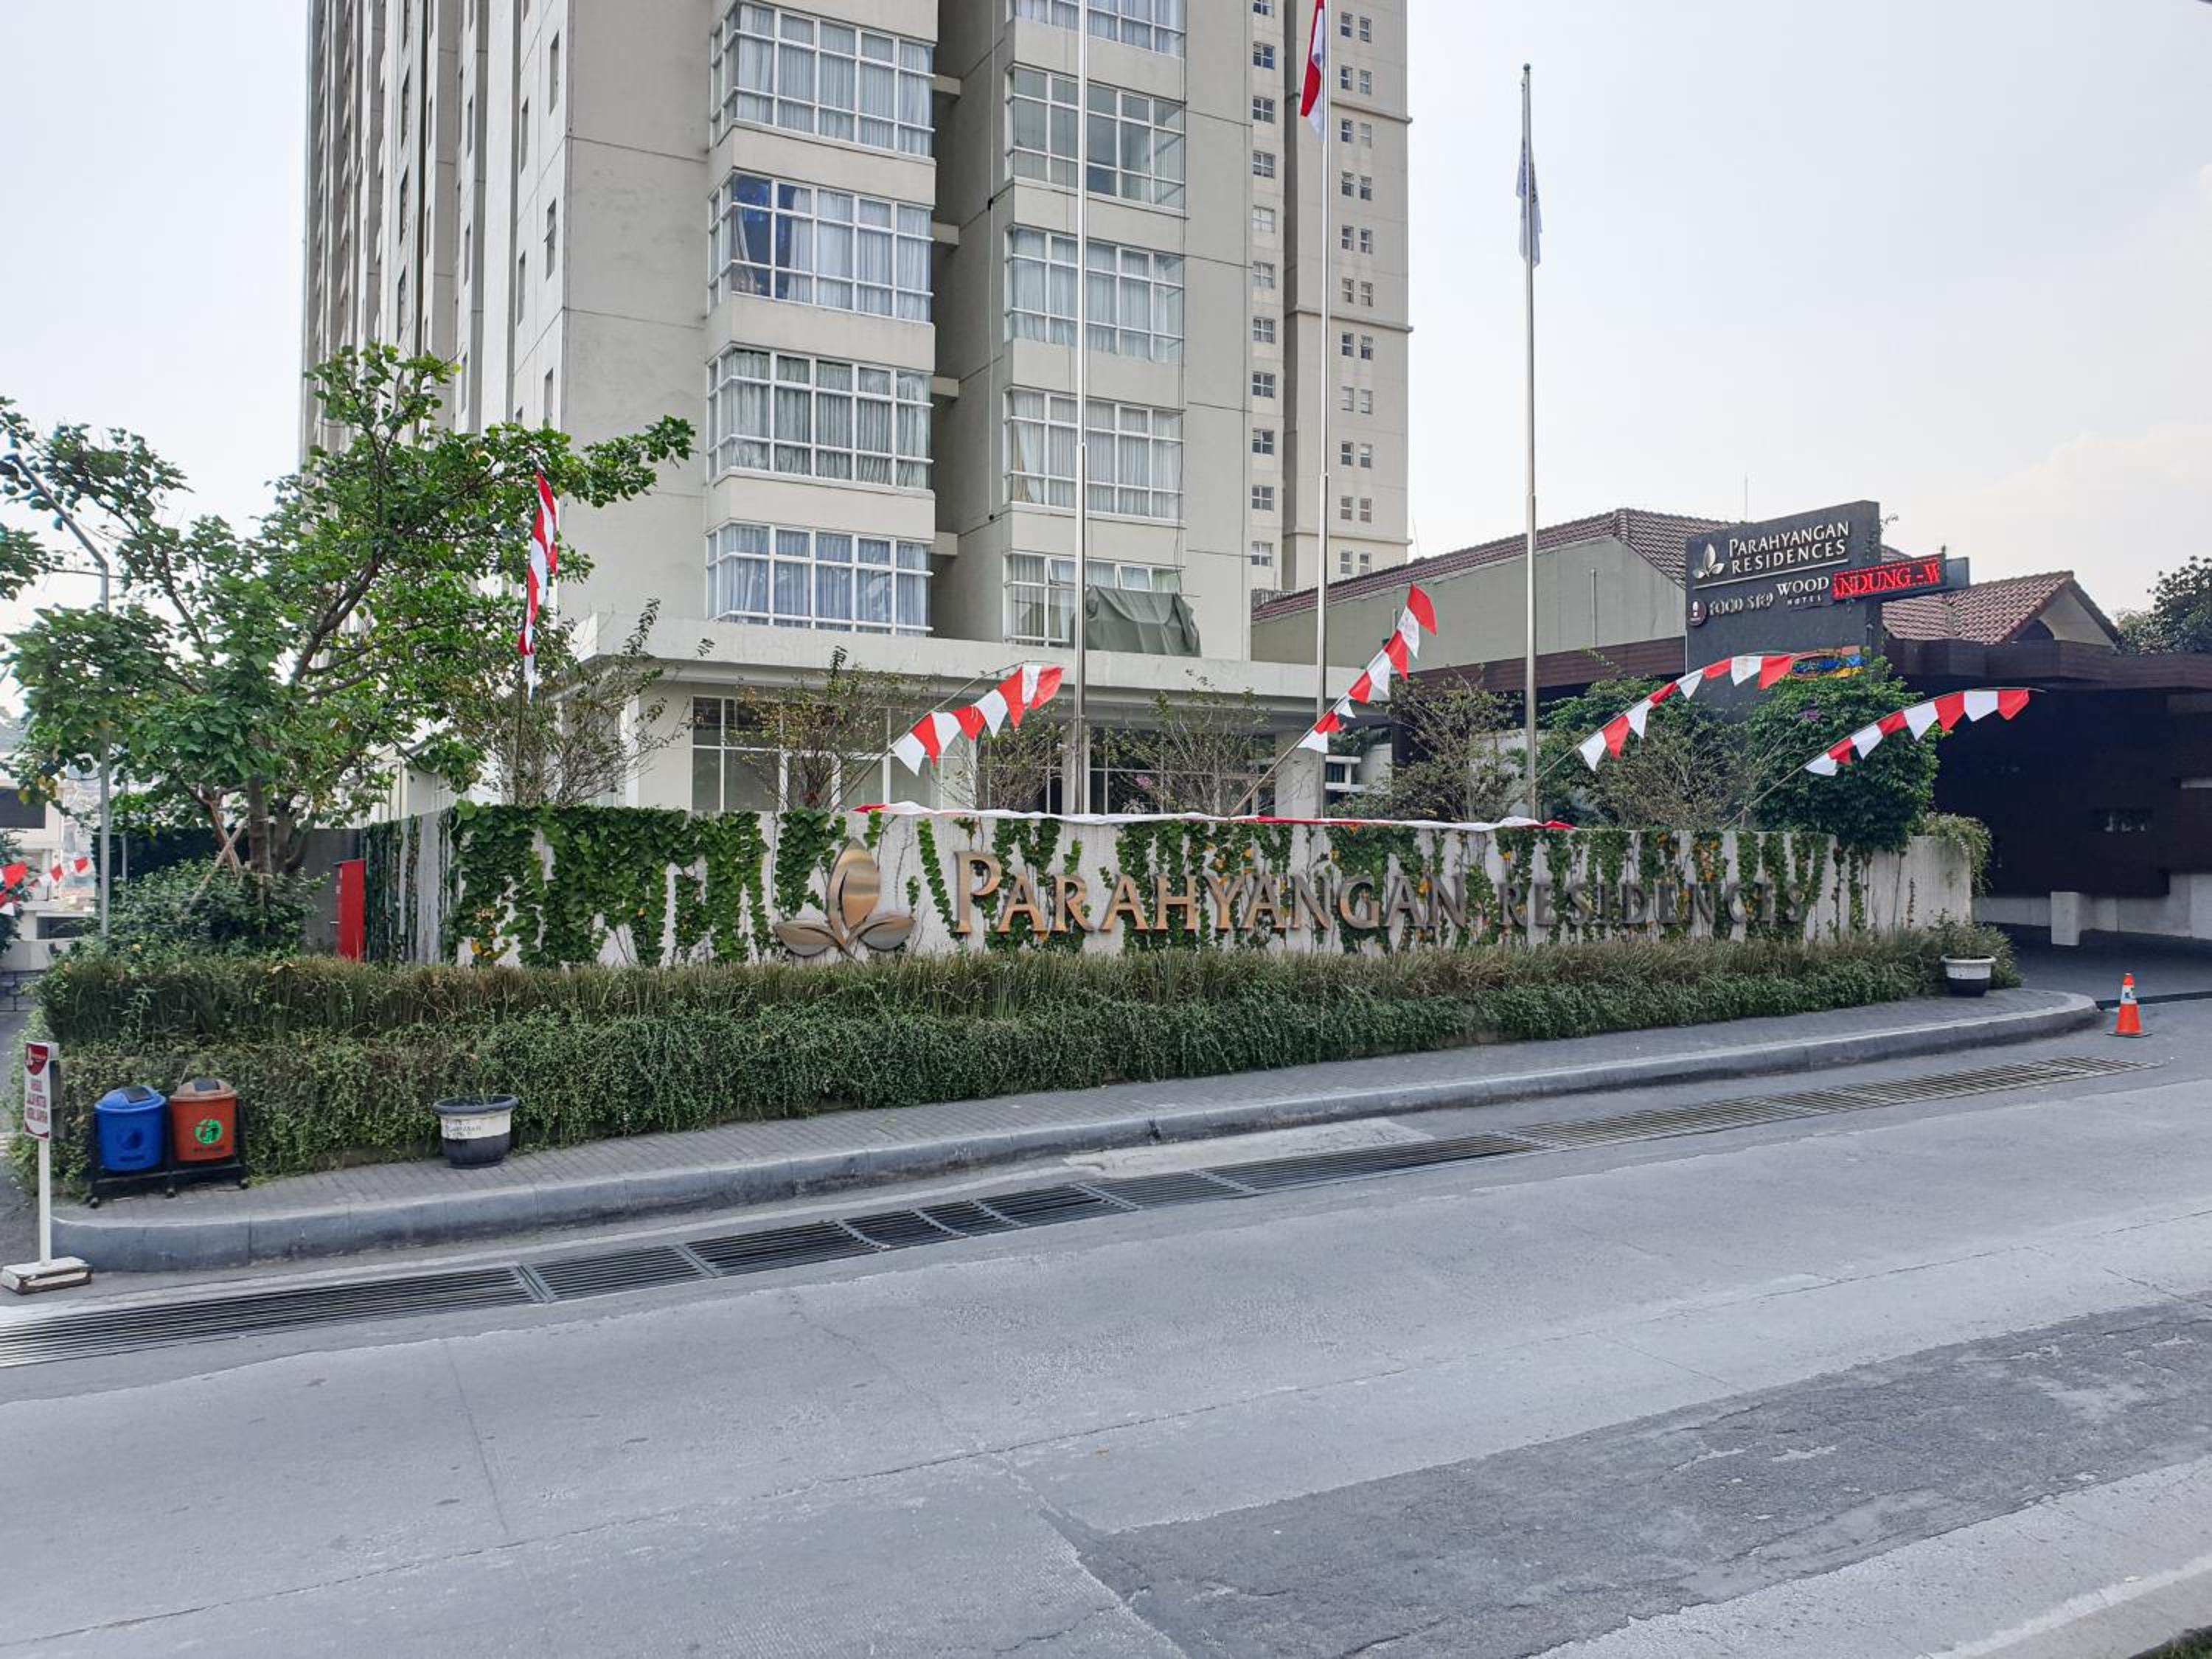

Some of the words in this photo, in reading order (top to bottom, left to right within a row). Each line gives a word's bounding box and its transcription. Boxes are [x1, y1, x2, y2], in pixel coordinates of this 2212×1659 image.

[1728, 520, 1849, 558] PARAHYANGAN
[1731, 539, 1846, 574] RESIDENCES
[1776, 577, 1829, 597] WOOD
[1787, 594, 1822, 606] HOTEL
[1709, 598, 1744, 616] FOOD
[953, 849, 1467, 934] PARAHYANGAN
